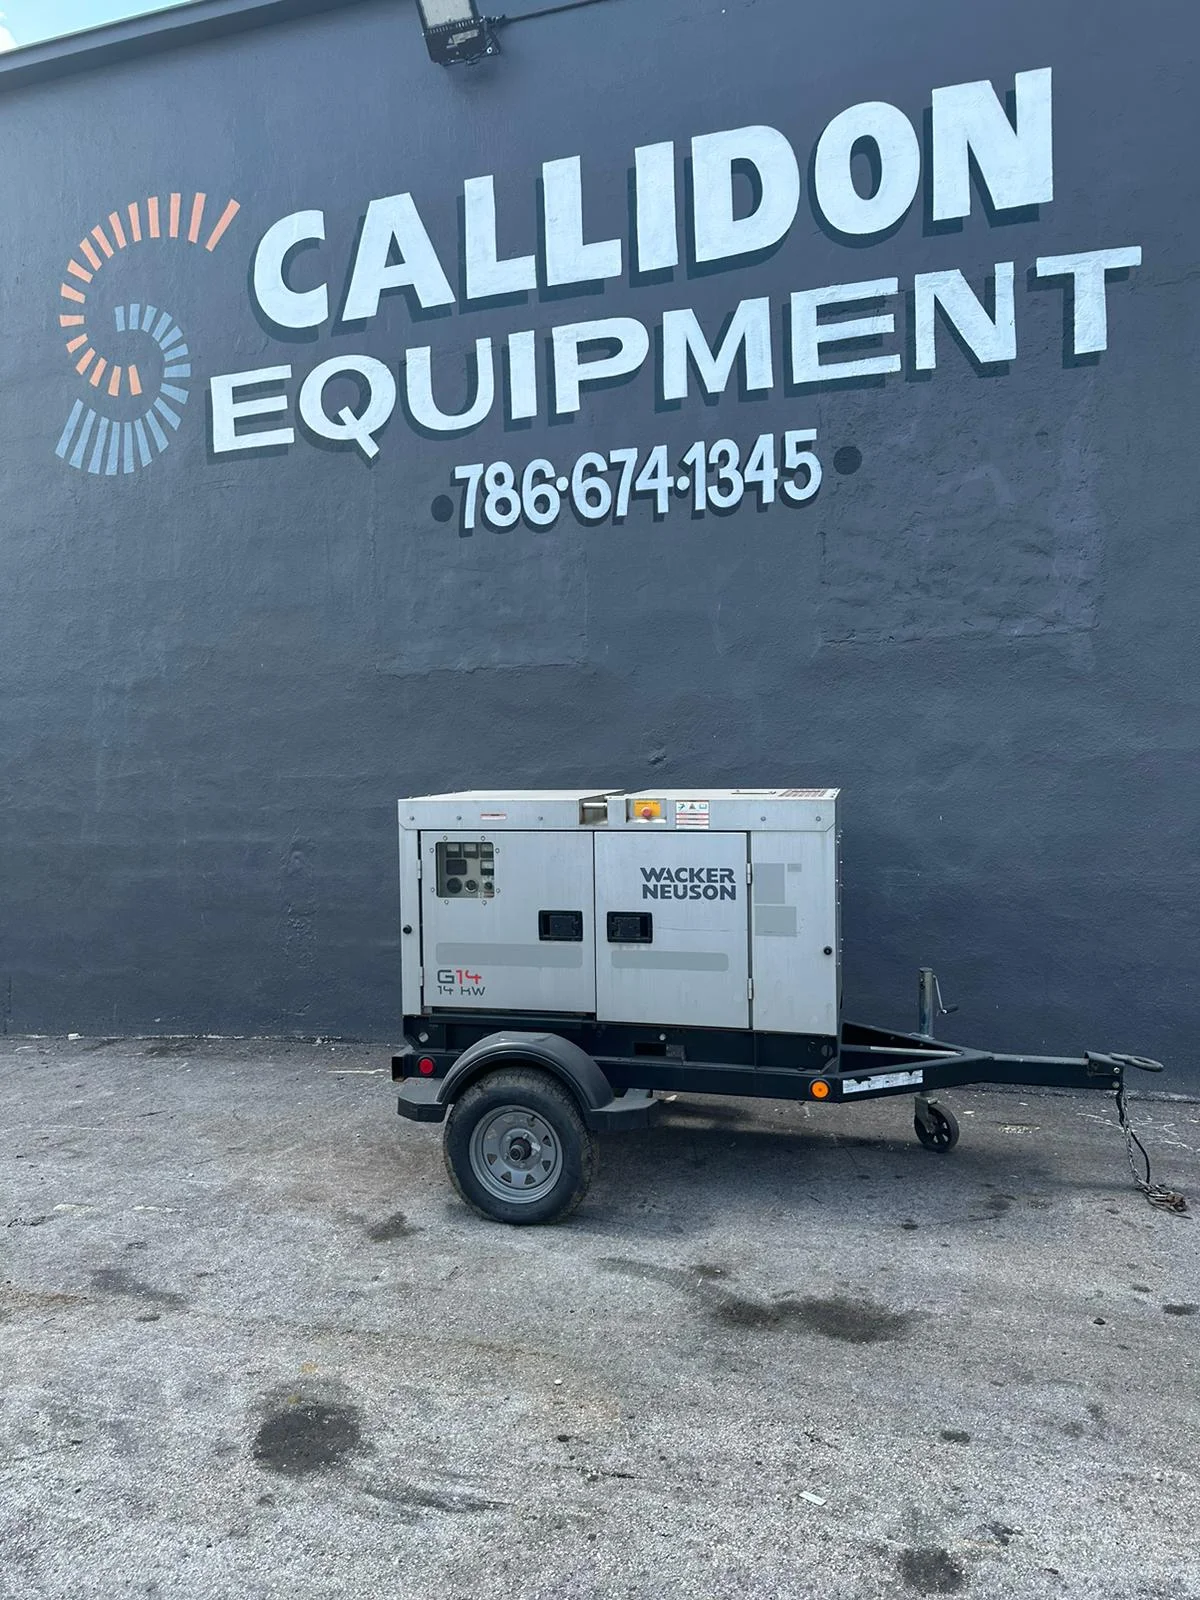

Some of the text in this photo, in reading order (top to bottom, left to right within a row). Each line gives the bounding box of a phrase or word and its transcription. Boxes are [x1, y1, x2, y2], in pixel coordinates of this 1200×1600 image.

[252, 67, 1053, 329] CALLIDON
[210, 246, 1141, 459] EQUIPMENT
[640, 867, 736, 883] WACKER
[642, 884, 736, 900] NEUSON
[437, 969, 482, 984] G14
[437, 986, 454, 995] 14
